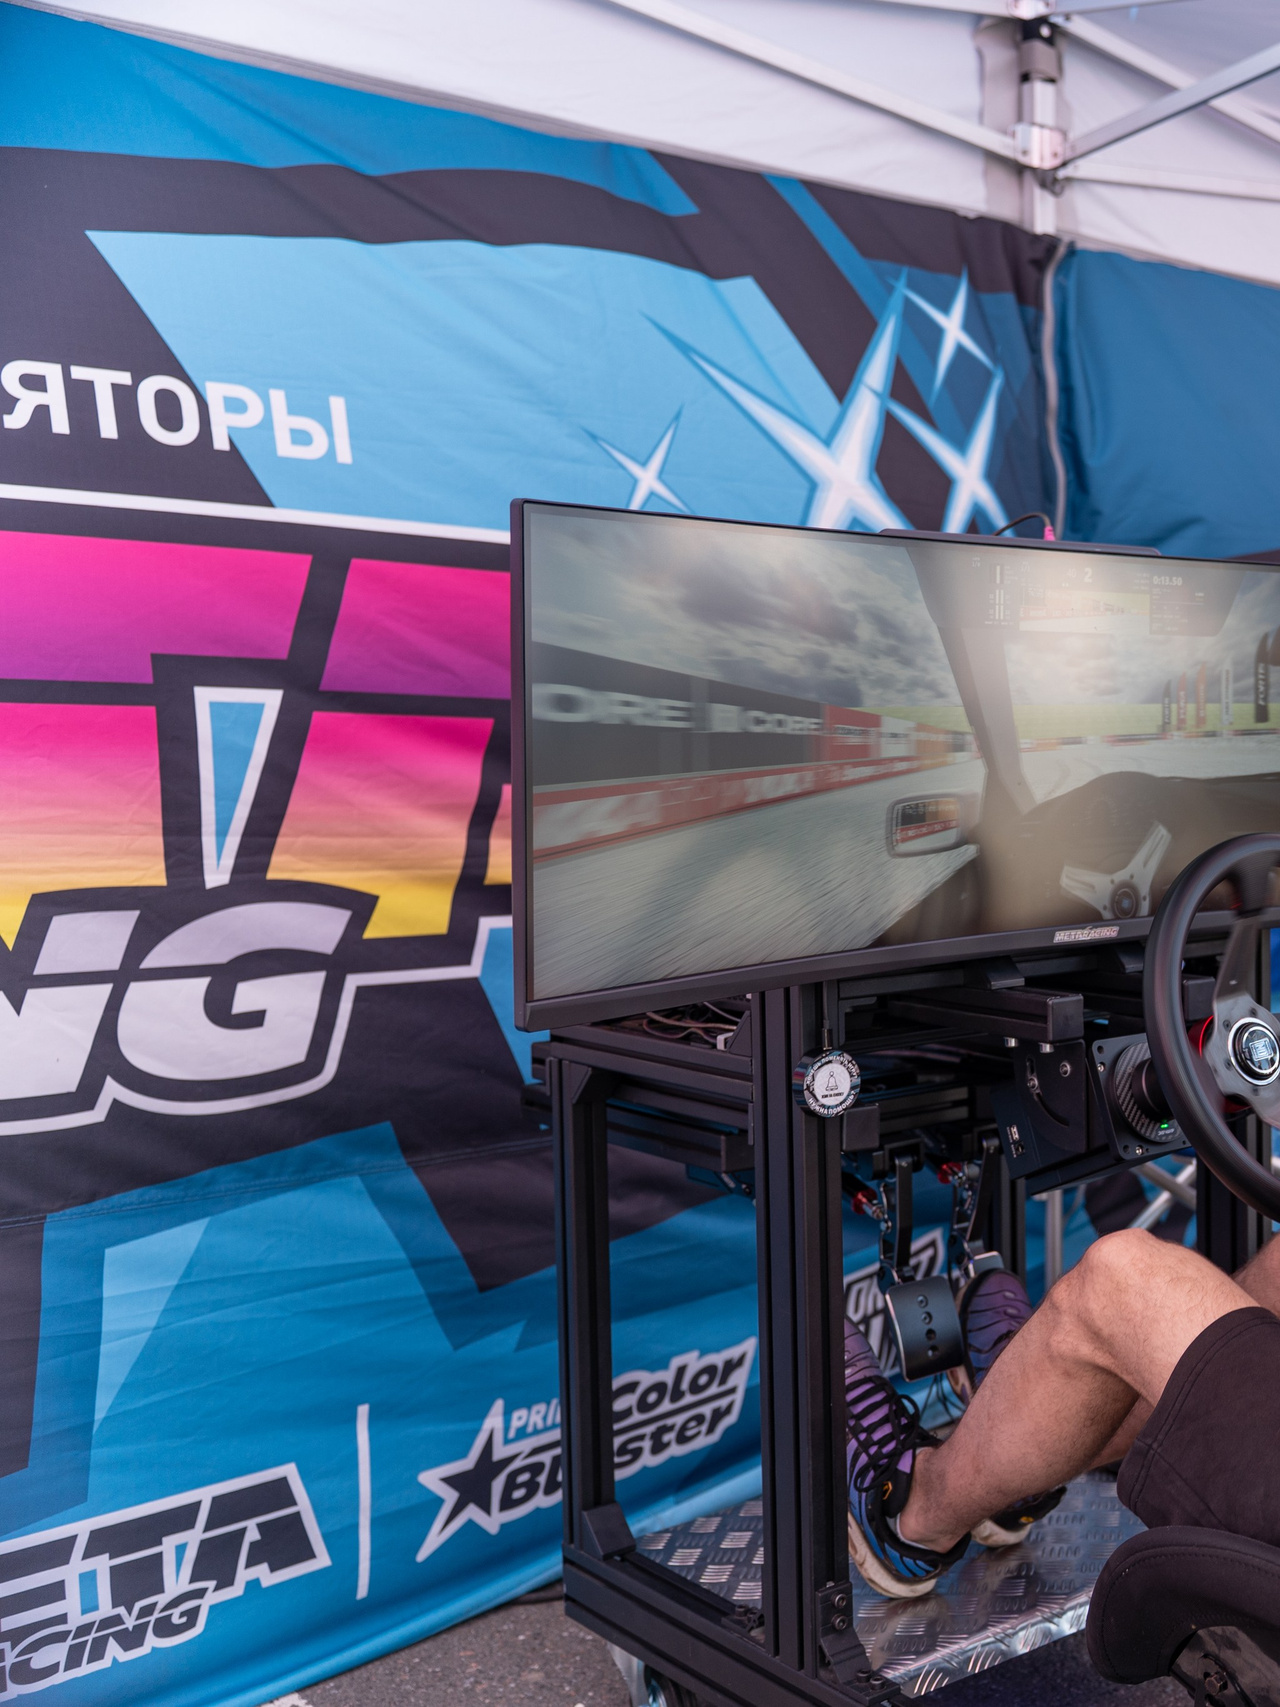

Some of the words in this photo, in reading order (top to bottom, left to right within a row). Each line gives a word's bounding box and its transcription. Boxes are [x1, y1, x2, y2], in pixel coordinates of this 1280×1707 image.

[0, 359, 353, 465] ЯТОРЫ
[1083, 567, 1093, 583] 2
[1152, 575, 1183, 587] 0:13.50
[508, 1398, 562, 1439] PRI
[612, 1351, 744, 1425] Color
[0, 1586, 211, 1694] CING
